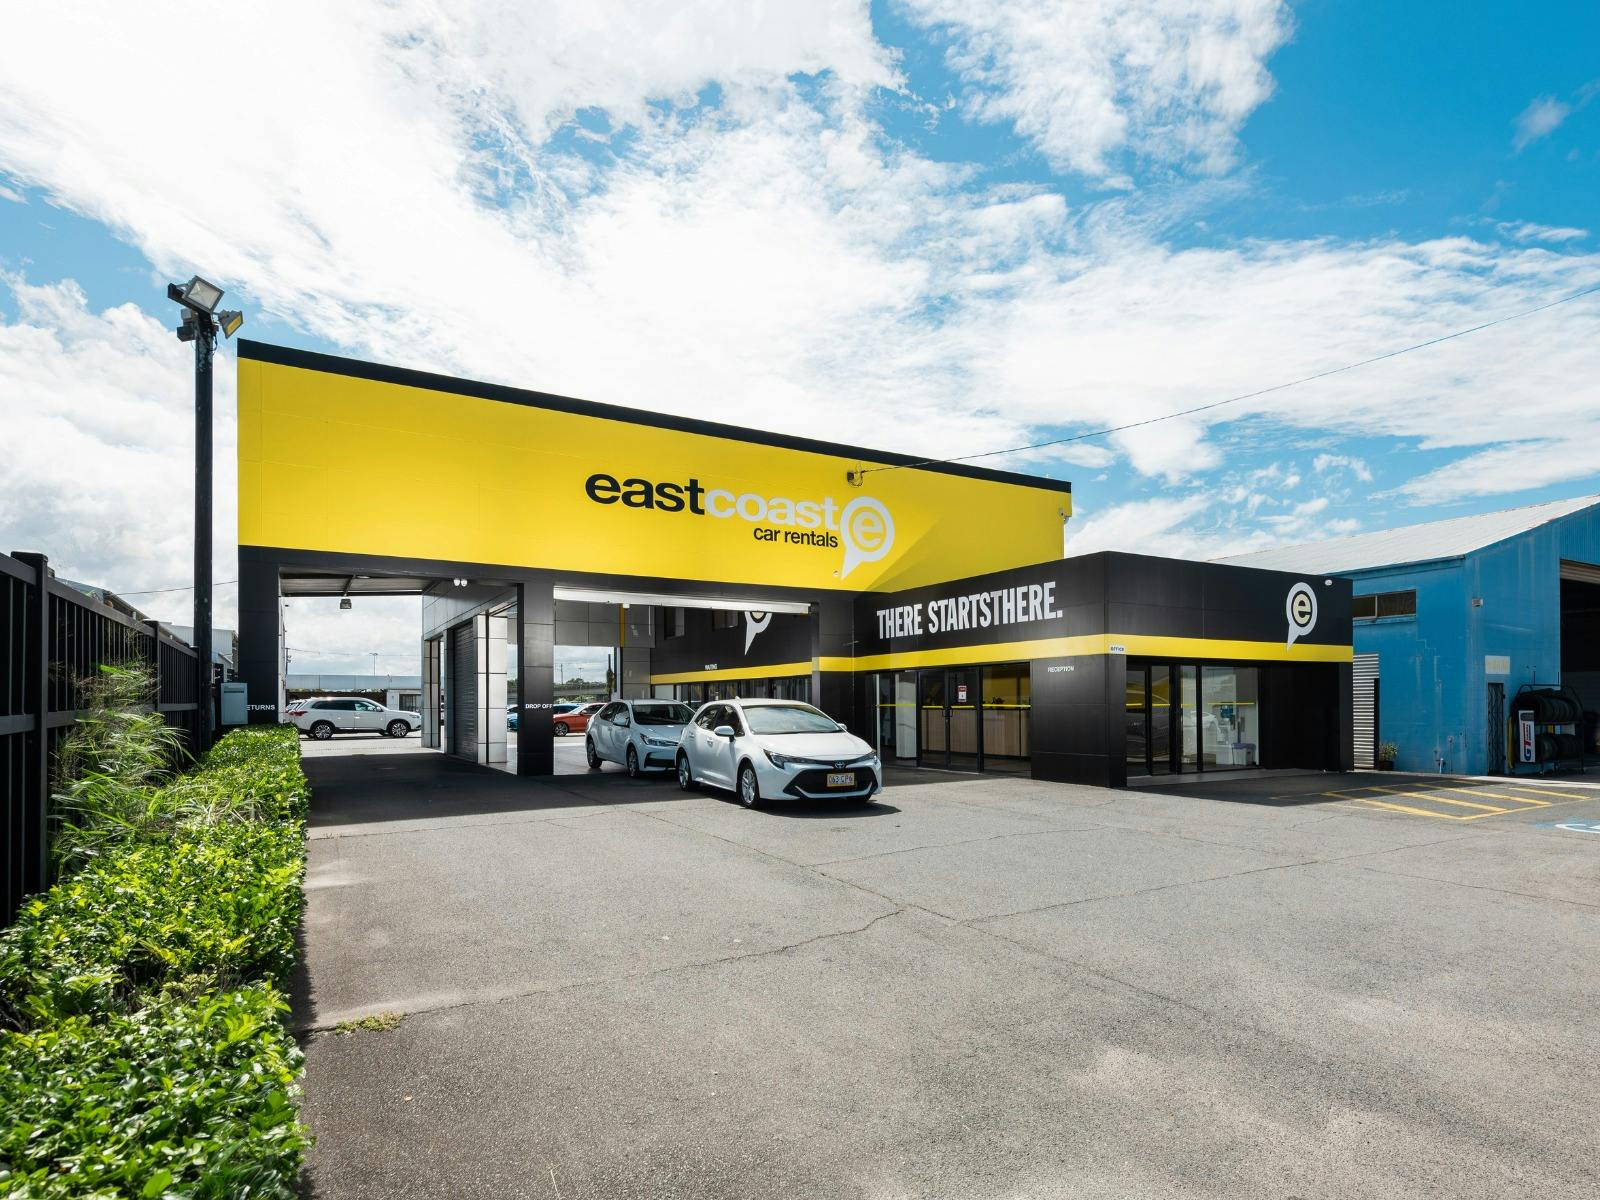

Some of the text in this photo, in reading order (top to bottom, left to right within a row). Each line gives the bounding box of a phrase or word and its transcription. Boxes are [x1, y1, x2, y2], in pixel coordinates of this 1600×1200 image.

[753, 527, 839, 548] car rentals
[876, 603, 923, 639] THERE
